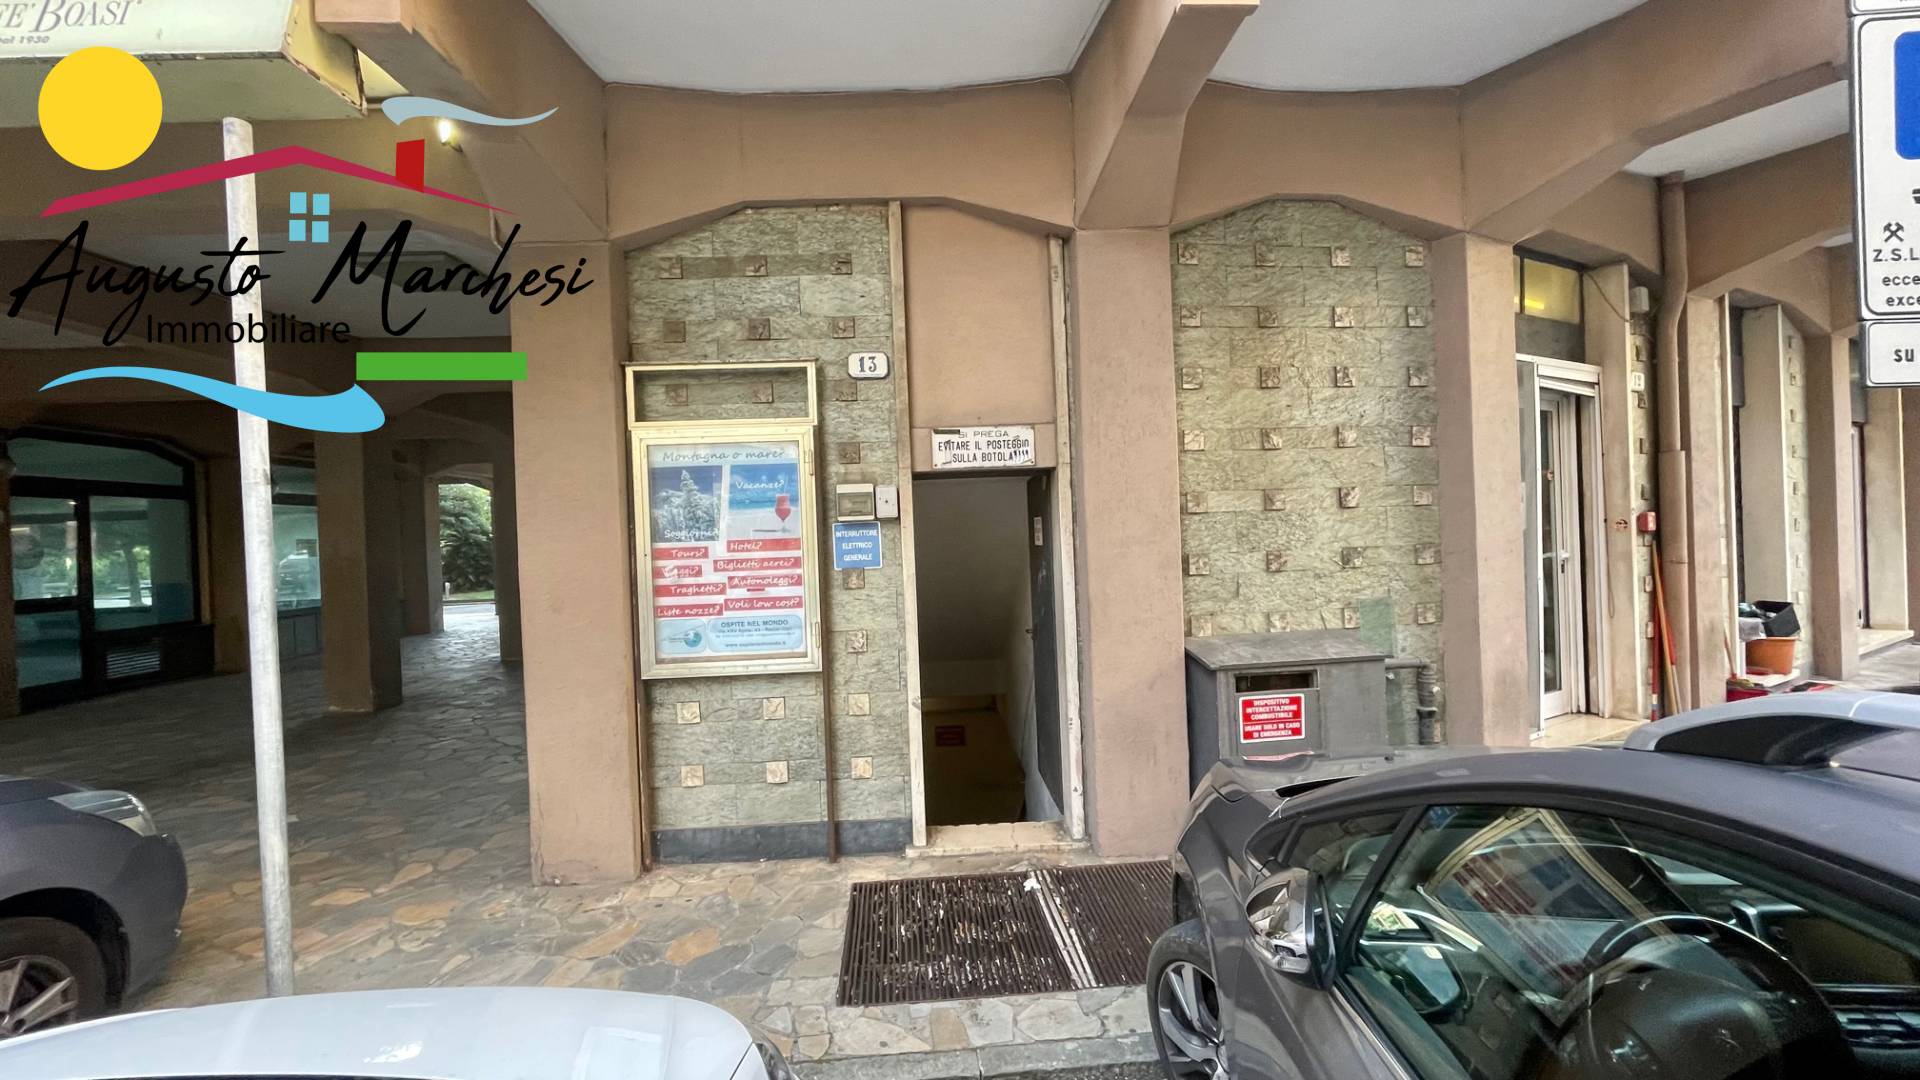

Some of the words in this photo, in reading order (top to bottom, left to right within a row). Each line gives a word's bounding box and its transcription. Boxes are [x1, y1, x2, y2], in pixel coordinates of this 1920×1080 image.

[19, 35, 50, 44] 1930
[1893, 348, 1914, 362] su
[858, 356, 877, 372] 13
[973, 430, 1009, 438] PREGA
[938, 440, 970, 451] EVITARE
[974, 441, 982, 450] IL
[986, 439, 1029, 450] POSTEGGIO
[662, 451, 728, 463] Montagna
[731, 451, 742, 460] o
[745, 449, 785, 460] mare?
[952, 452, 977, 463] SULLA
[735, 479, 785, 490] Vacanze?
[729, 540, 762, 551] Hotel?
[842, 541, 873, 550] ELETTRICO
[671, 548, 705, 558] Tours?
[843, 553, 873, 561] GENERALE
[717, 559, 761, 571] Biglietti
[763, 558, 794, 568] aerei?
[731, 575, 798, 587] Autonoleggi?
[670, 583, 723, 596] Traghetti?
[727, 598, 751, 609] Voli
[753, 598, 774, 608] low
[775, 596, 800, 608] cost?
[657, 606, 682, 617] Liste
[684, 604, 719, 615] nozze?
[1253, 698, 1290, 706] DISPOSITIVO
[1246, 704, 1298, 713] INTERCETTAZIONE
[1250, 711, 1293, 720] COMBUSTIBILE
